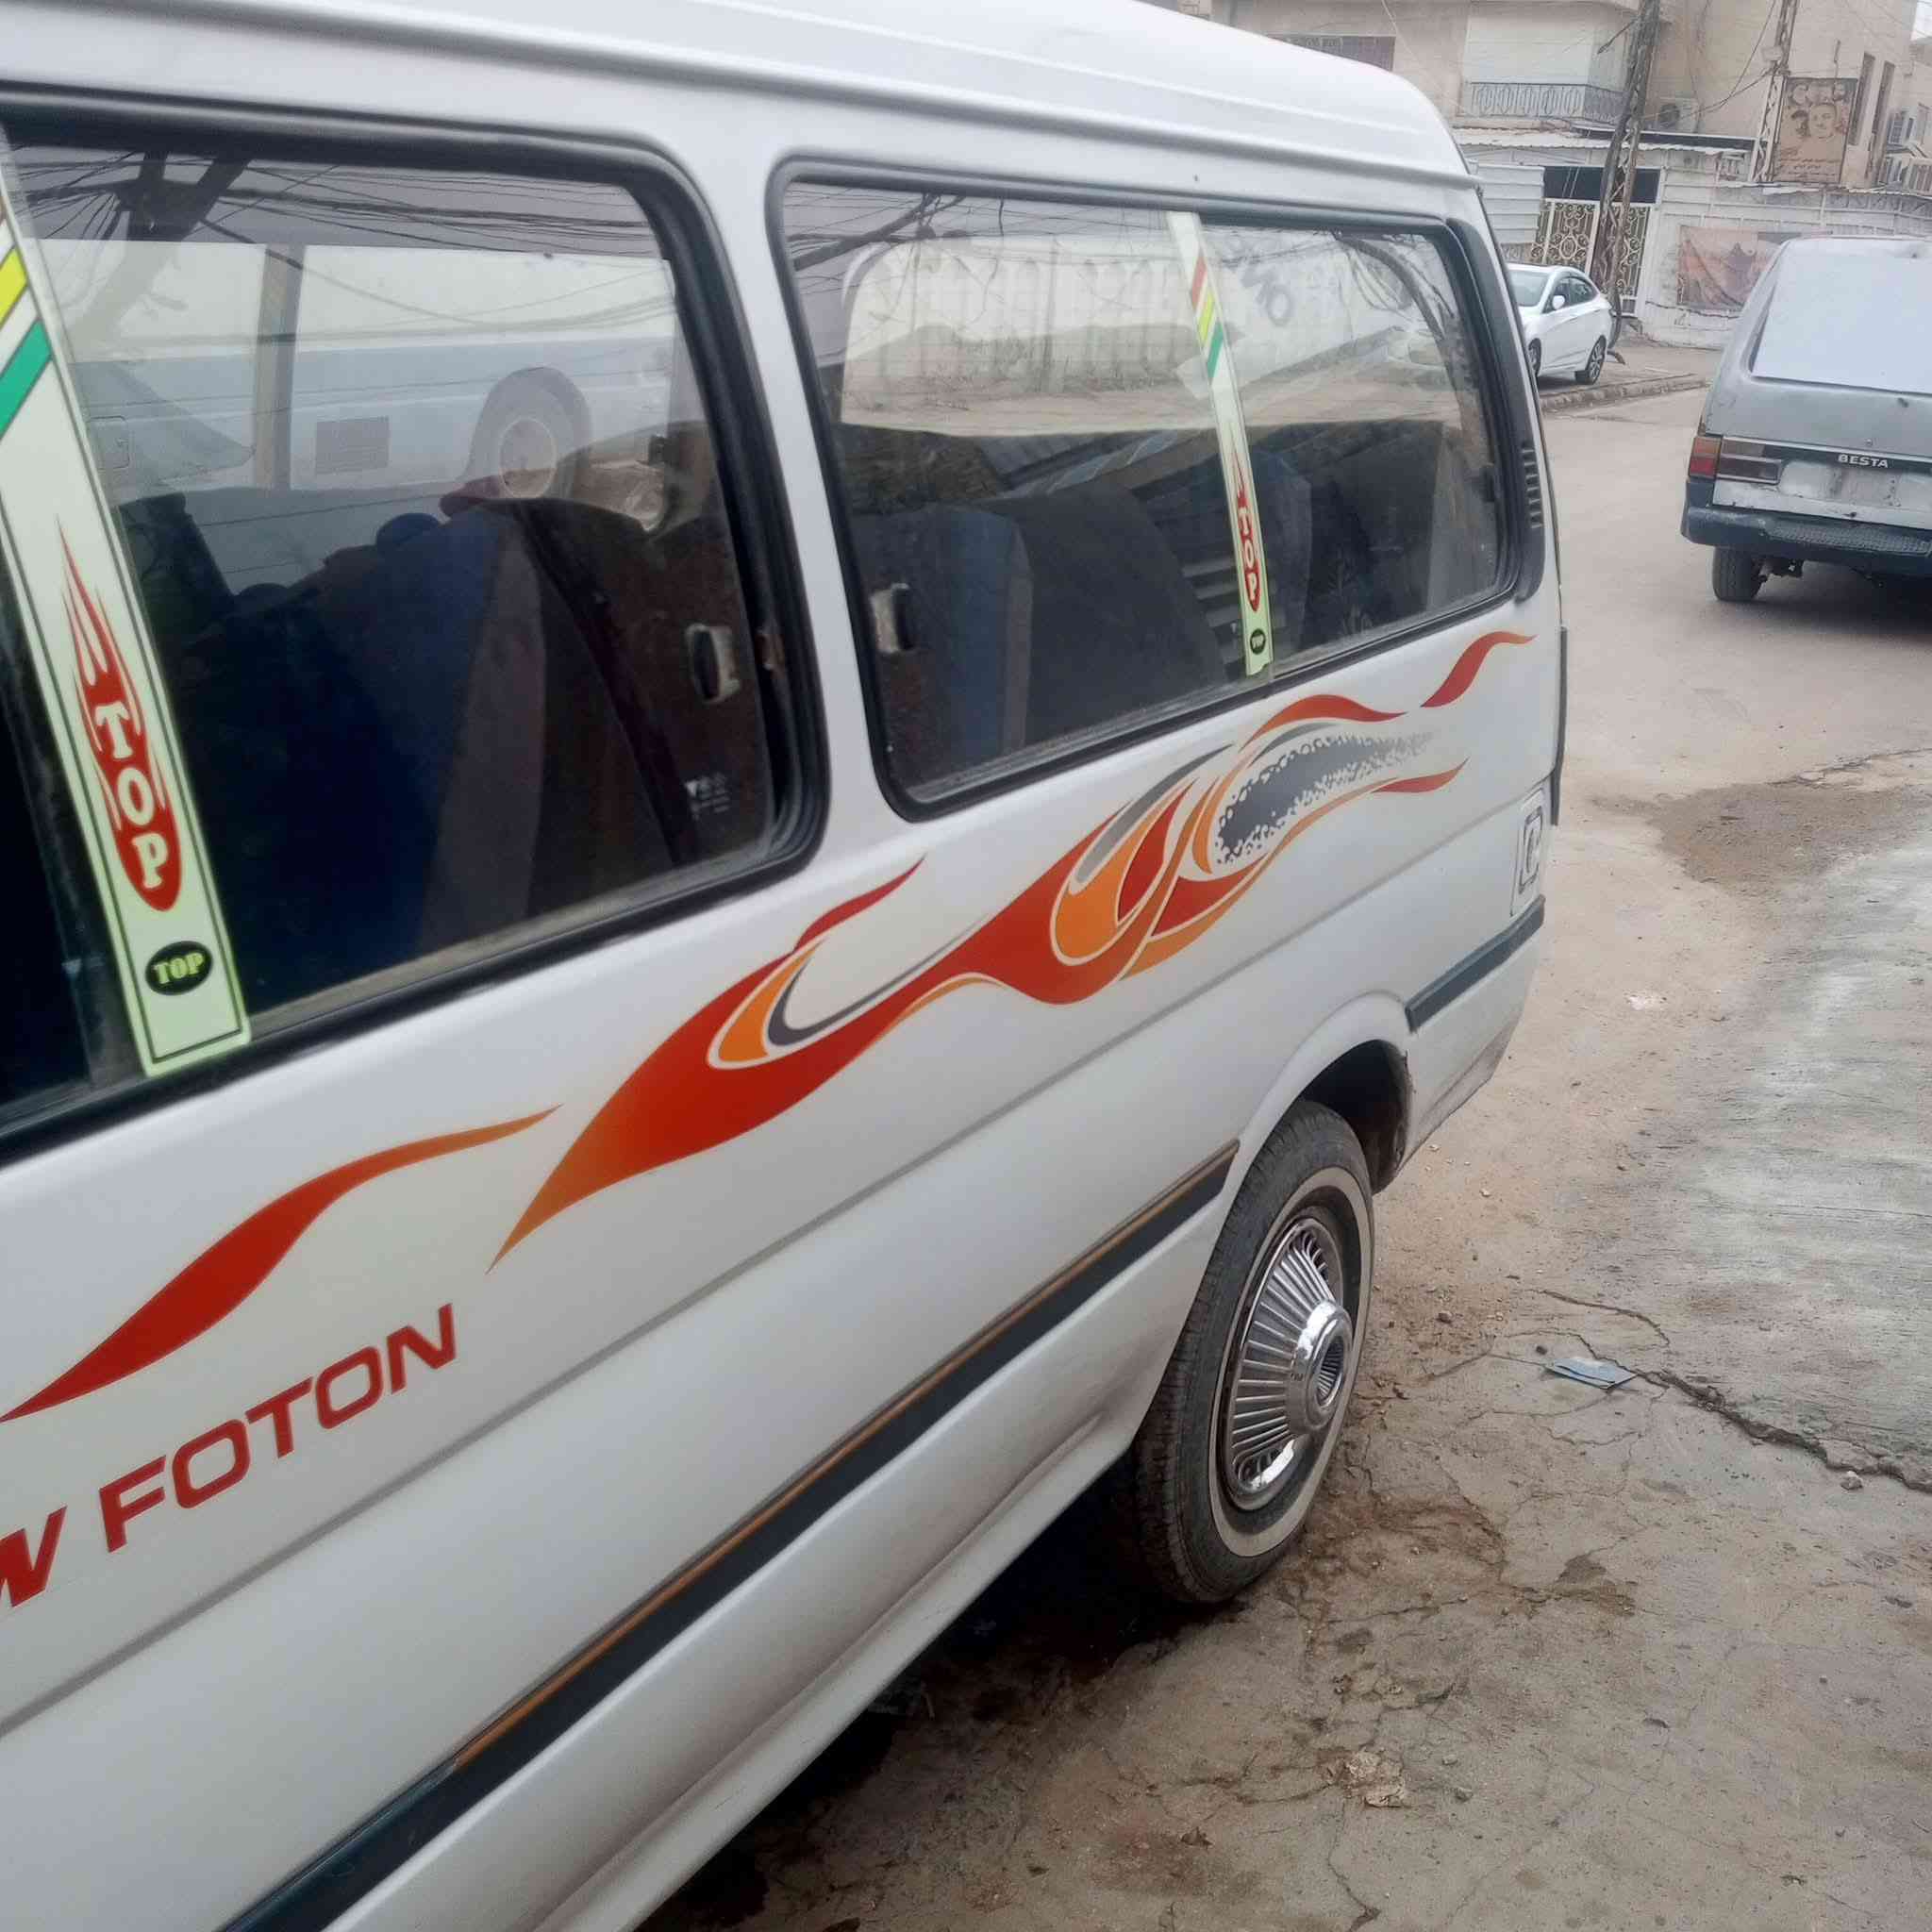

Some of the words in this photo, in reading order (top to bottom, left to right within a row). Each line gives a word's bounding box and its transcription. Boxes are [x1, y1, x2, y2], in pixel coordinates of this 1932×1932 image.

[1838, 454, 1889, 468] BESTA
[1238, 507, 1257, 601] TOP
[94, 701, 169, 890] TOP
[153, 952, 206, 985] TOP
[98, 1302, 457, 1554] FOTON
